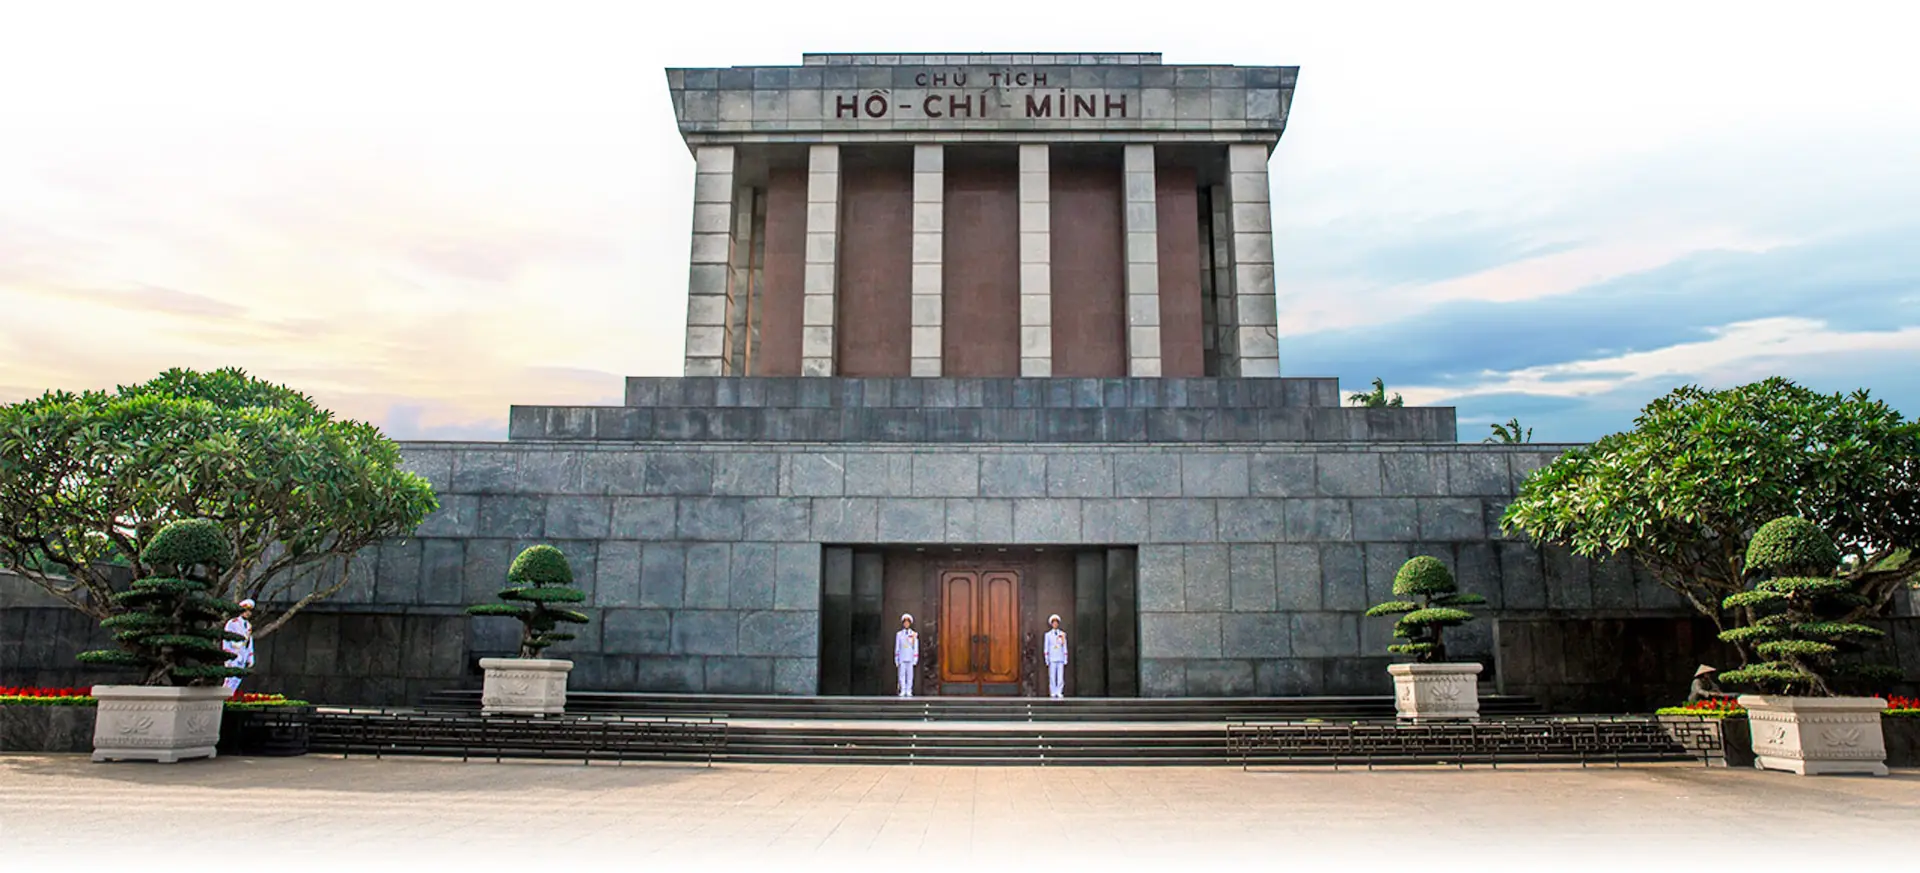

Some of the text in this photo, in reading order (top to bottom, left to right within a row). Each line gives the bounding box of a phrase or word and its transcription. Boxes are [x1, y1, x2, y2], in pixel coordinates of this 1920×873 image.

[915, 67, 967, 87] CHỦ
[836, 89, 889, 118] HỒ
[923, 86, 992, 118] CHÍ
